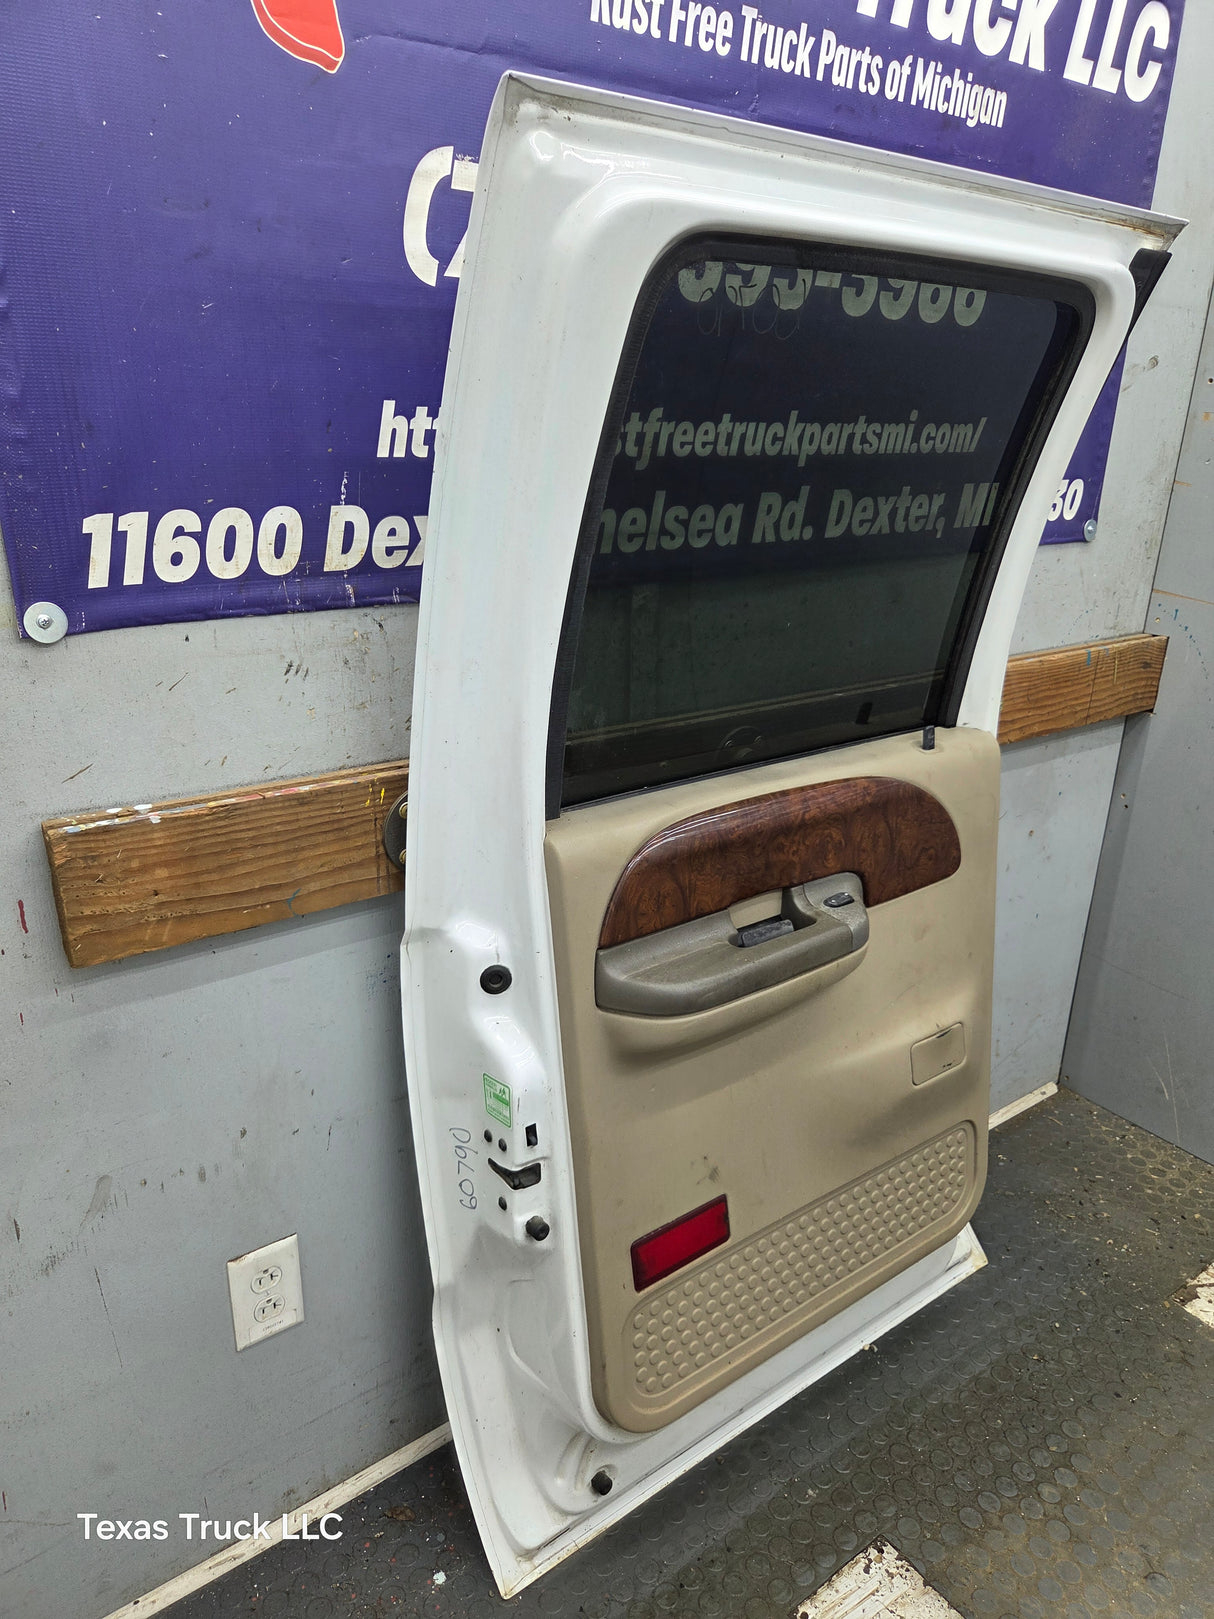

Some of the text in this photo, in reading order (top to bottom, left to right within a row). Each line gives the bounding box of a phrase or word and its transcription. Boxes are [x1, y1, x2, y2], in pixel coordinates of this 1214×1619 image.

[668, 0, 734, 56] Free
[740, 5, 816, 78] Truck
[816, 28, 883, 96] Parts
[884, 55, 914, 102] of
[911, 57, 1008, 128] Michigan
[856, 0, 1170, 102] uck LLC
[615, 407, 986, 471] tfreetruckpartsmi.com/
[82, 505, 304, 589] 11600
[751, 485, 814, 543] Rd.
[824, 486, 947, 539] Dexter,
[953, 482, 1000, 529] MI
